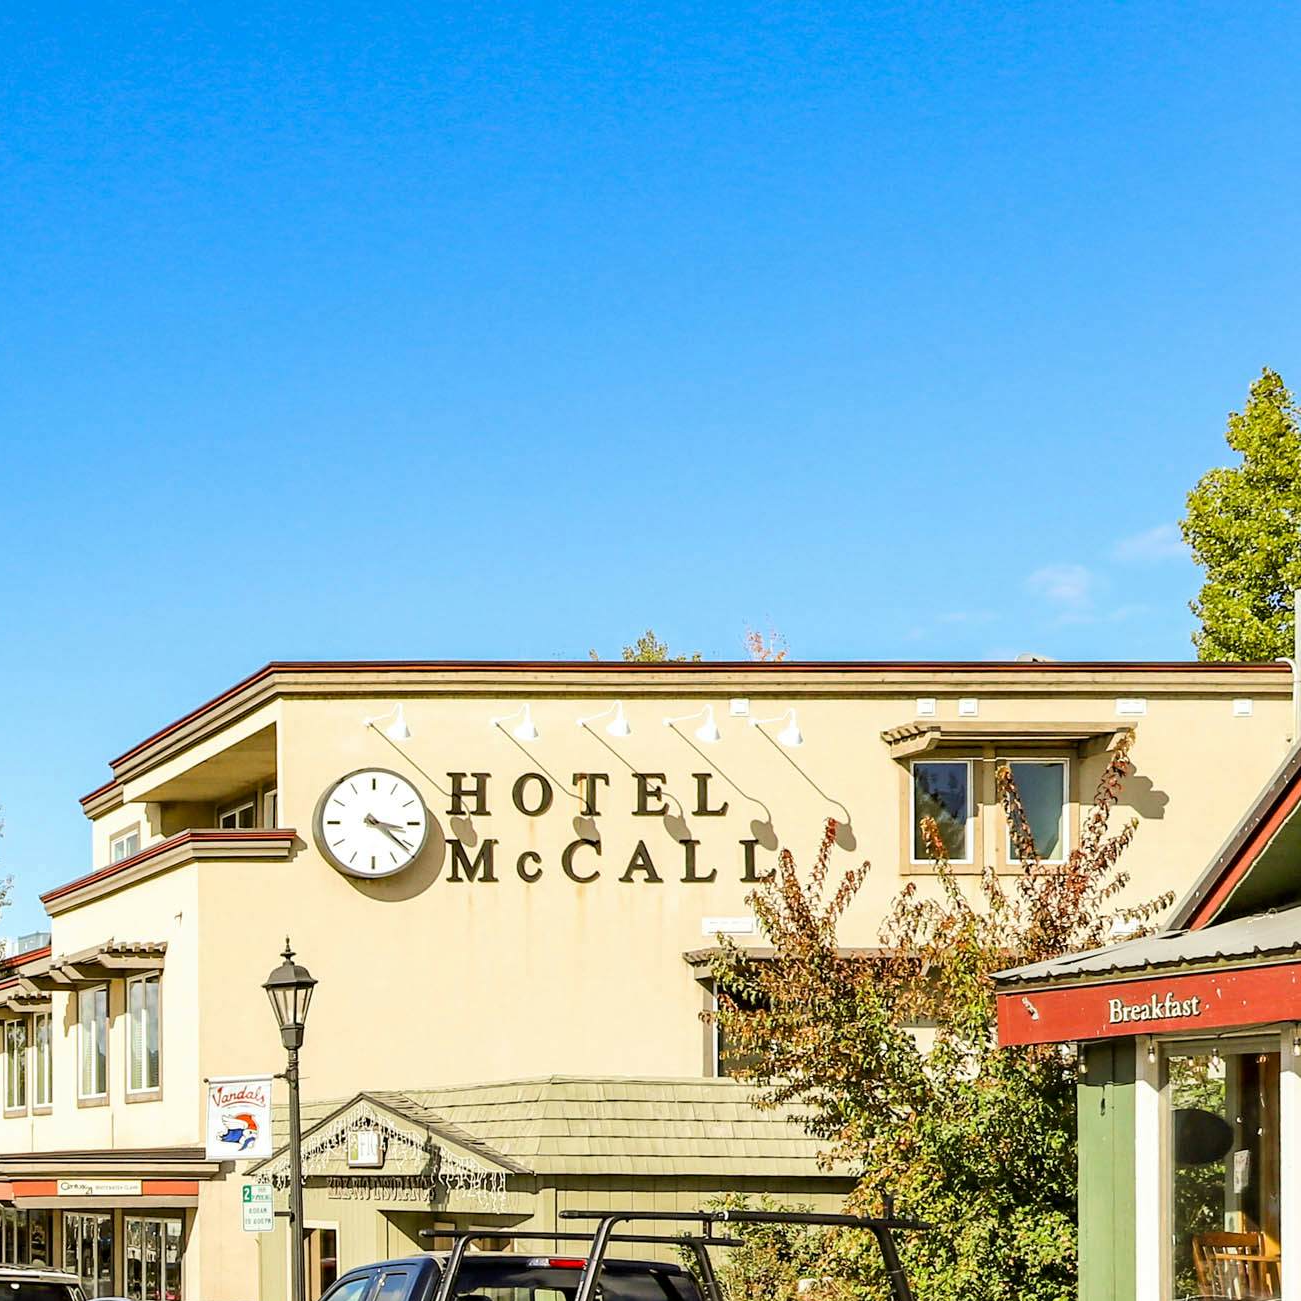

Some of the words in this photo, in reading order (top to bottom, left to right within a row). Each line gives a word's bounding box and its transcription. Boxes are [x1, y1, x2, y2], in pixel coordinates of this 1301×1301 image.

[446, 772, 729, 817] HOTEL
[445, 838, 777, 884] McCALL
[1108, 992, 1201, 1024] Breakfast
[212, 1086, 266, 1107] Vandals
[243, 1187, 251, 1201] 2
